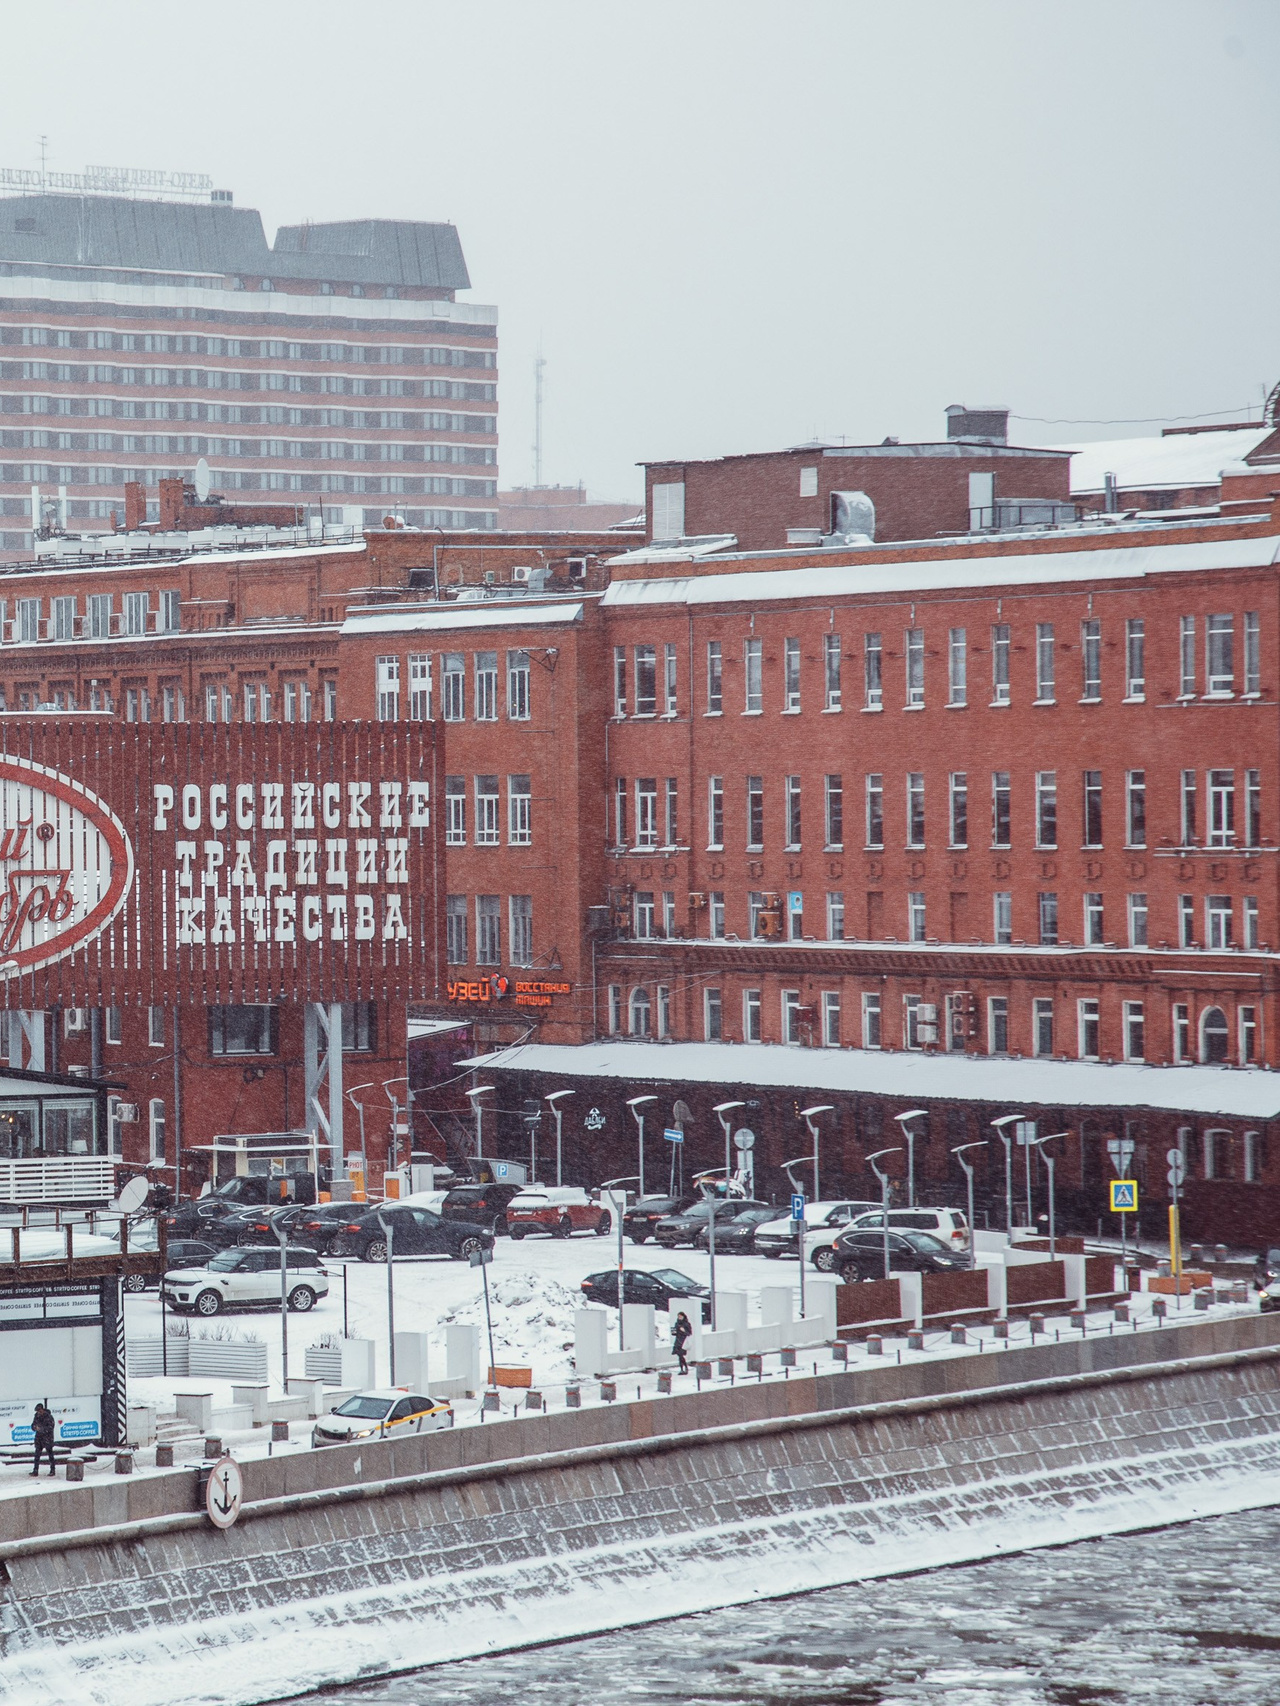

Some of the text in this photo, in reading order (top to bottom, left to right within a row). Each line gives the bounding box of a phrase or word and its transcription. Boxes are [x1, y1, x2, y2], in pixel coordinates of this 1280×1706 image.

[154, 781, 431, 831] РОССИЙСКИЕ
[176, 837, 409, 891] ТРАДИЦИИ
[178, 893, 409, 944] КАЧЕСТВА
[447, 977, 490, 1001] УЗЕЙ
